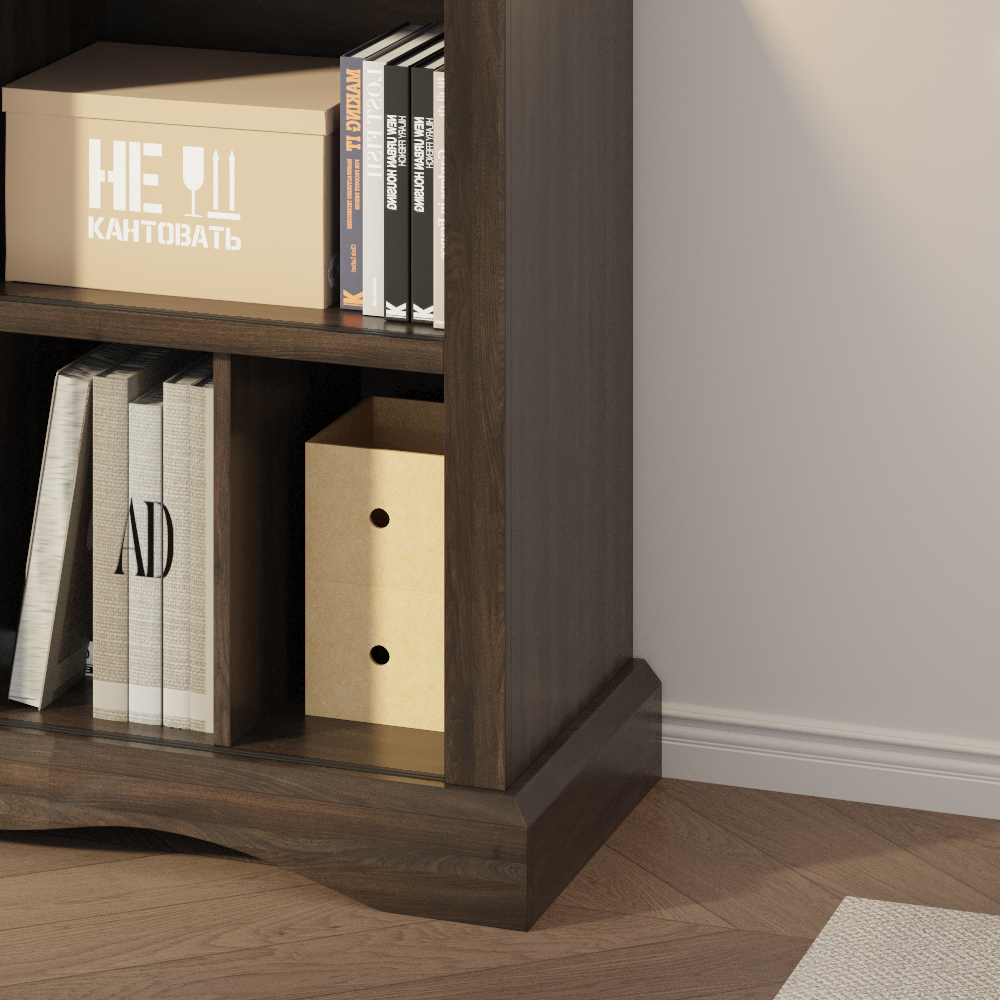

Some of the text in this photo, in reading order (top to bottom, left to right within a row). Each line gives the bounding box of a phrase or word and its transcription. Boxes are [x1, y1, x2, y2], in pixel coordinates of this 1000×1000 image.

[89, 138, 162, 214] НЕ
[88, 216, 241, 251] КАНТОВАТЬ
[114, 498, 174, 579] AD
